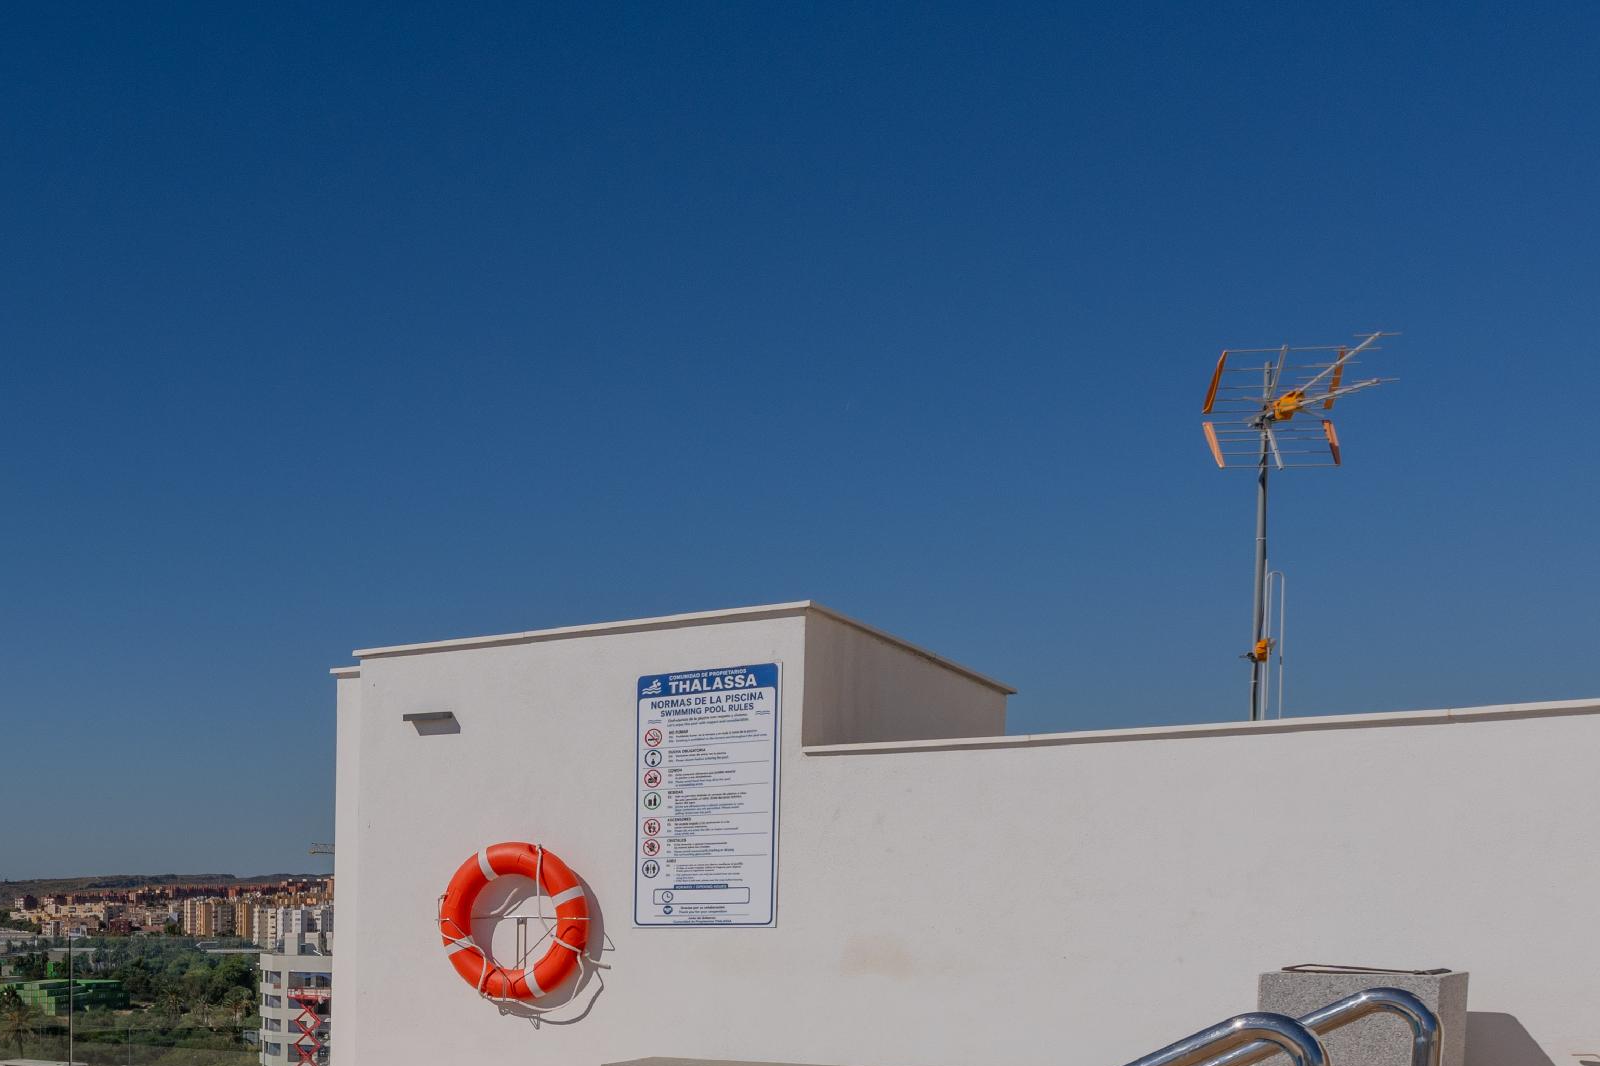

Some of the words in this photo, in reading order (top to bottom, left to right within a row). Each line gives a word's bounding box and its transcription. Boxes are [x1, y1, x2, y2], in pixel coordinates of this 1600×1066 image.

[669, 674, 757, 694] THALASSA
[650, 698, 692, 710] NORMAS
[694, 697, 707, 705] DE
[710, 696, 722, 704] LA
[725, 692, 763, 702] PISCINA
[660, 708, 702, 717] SWIMMING
[729, 703, 754, 711] RULES
